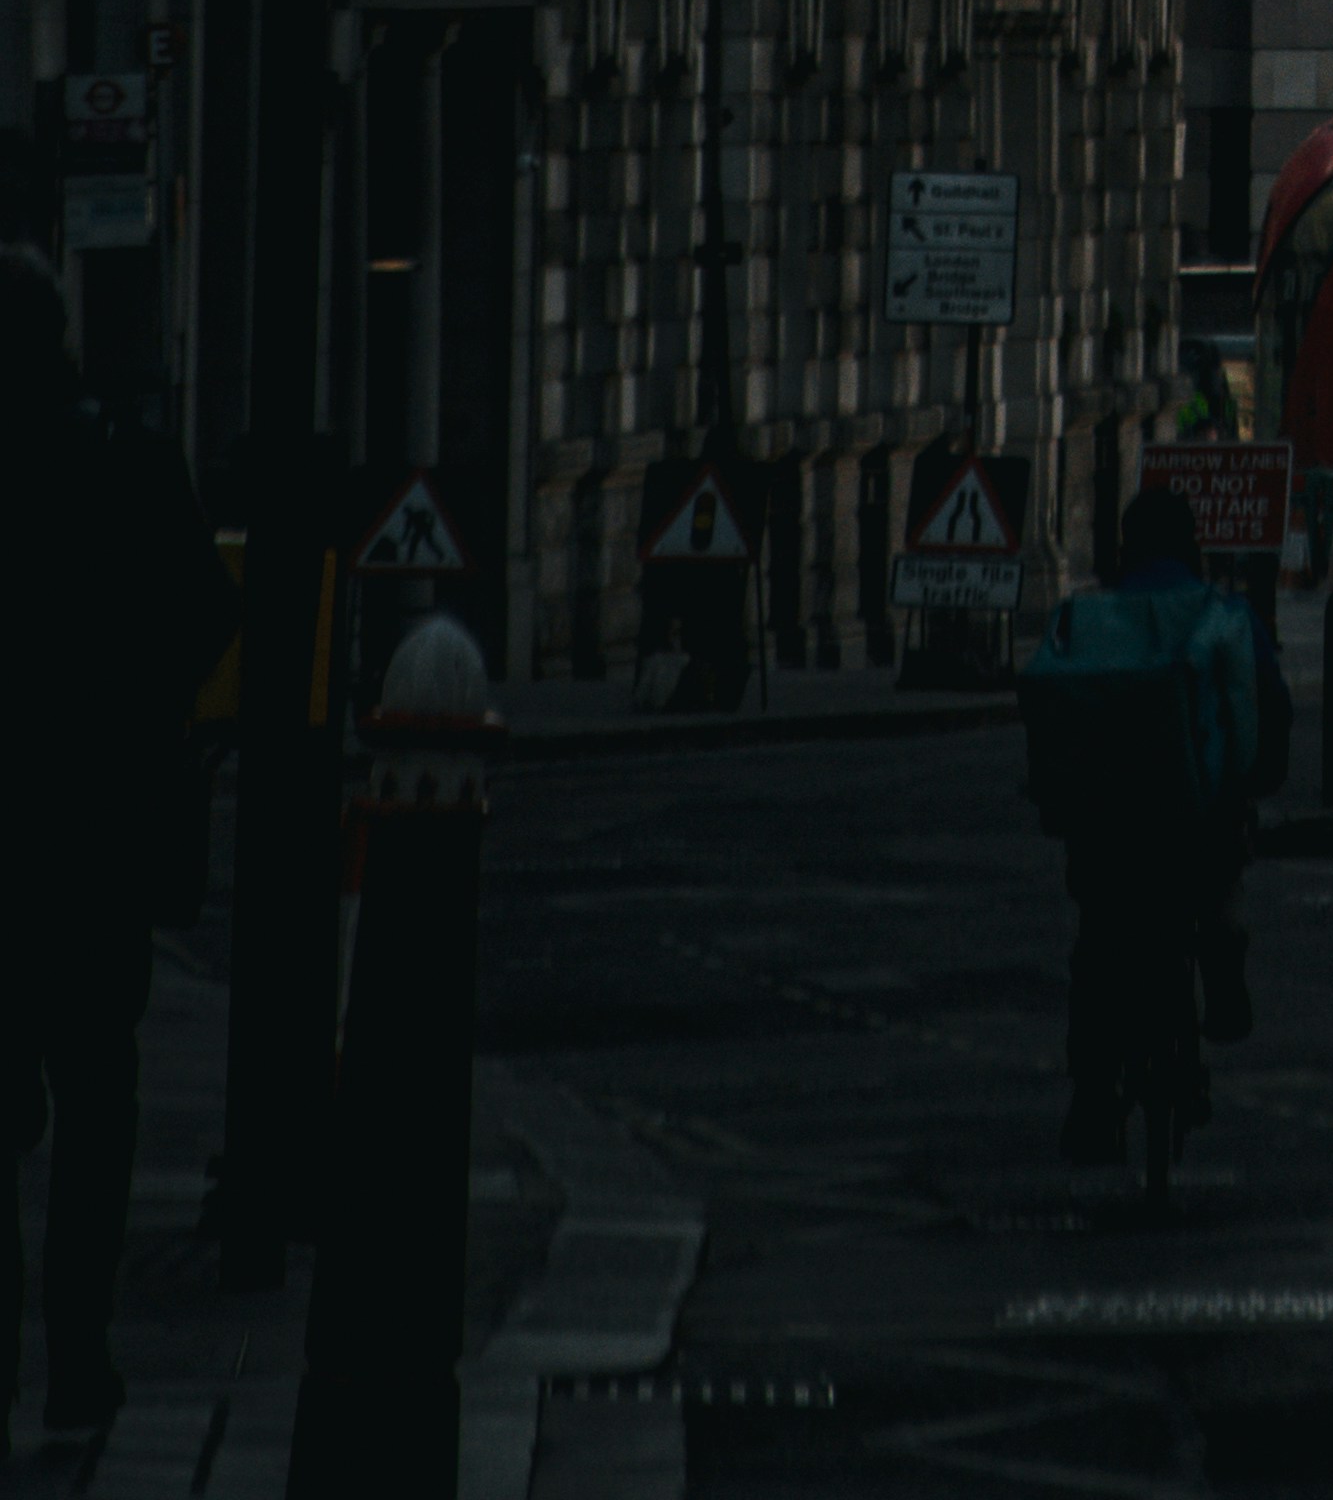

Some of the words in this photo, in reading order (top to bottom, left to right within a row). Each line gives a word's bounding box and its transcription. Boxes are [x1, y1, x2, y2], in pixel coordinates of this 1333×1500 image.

[149, 29, 174, 64] E
[925, 255, 980, 267] London
[1144, 453, 1222, 471] NARROW
[1230, 453, 1287, 470] LANES
[1169, 475, 1203, 495] DO
[1210, 474, 1257, 494] NOT
[904, 560, 967, 583] Single
[981, 564, 1014, 582] file
[923, 585, 988, 603] traffic
